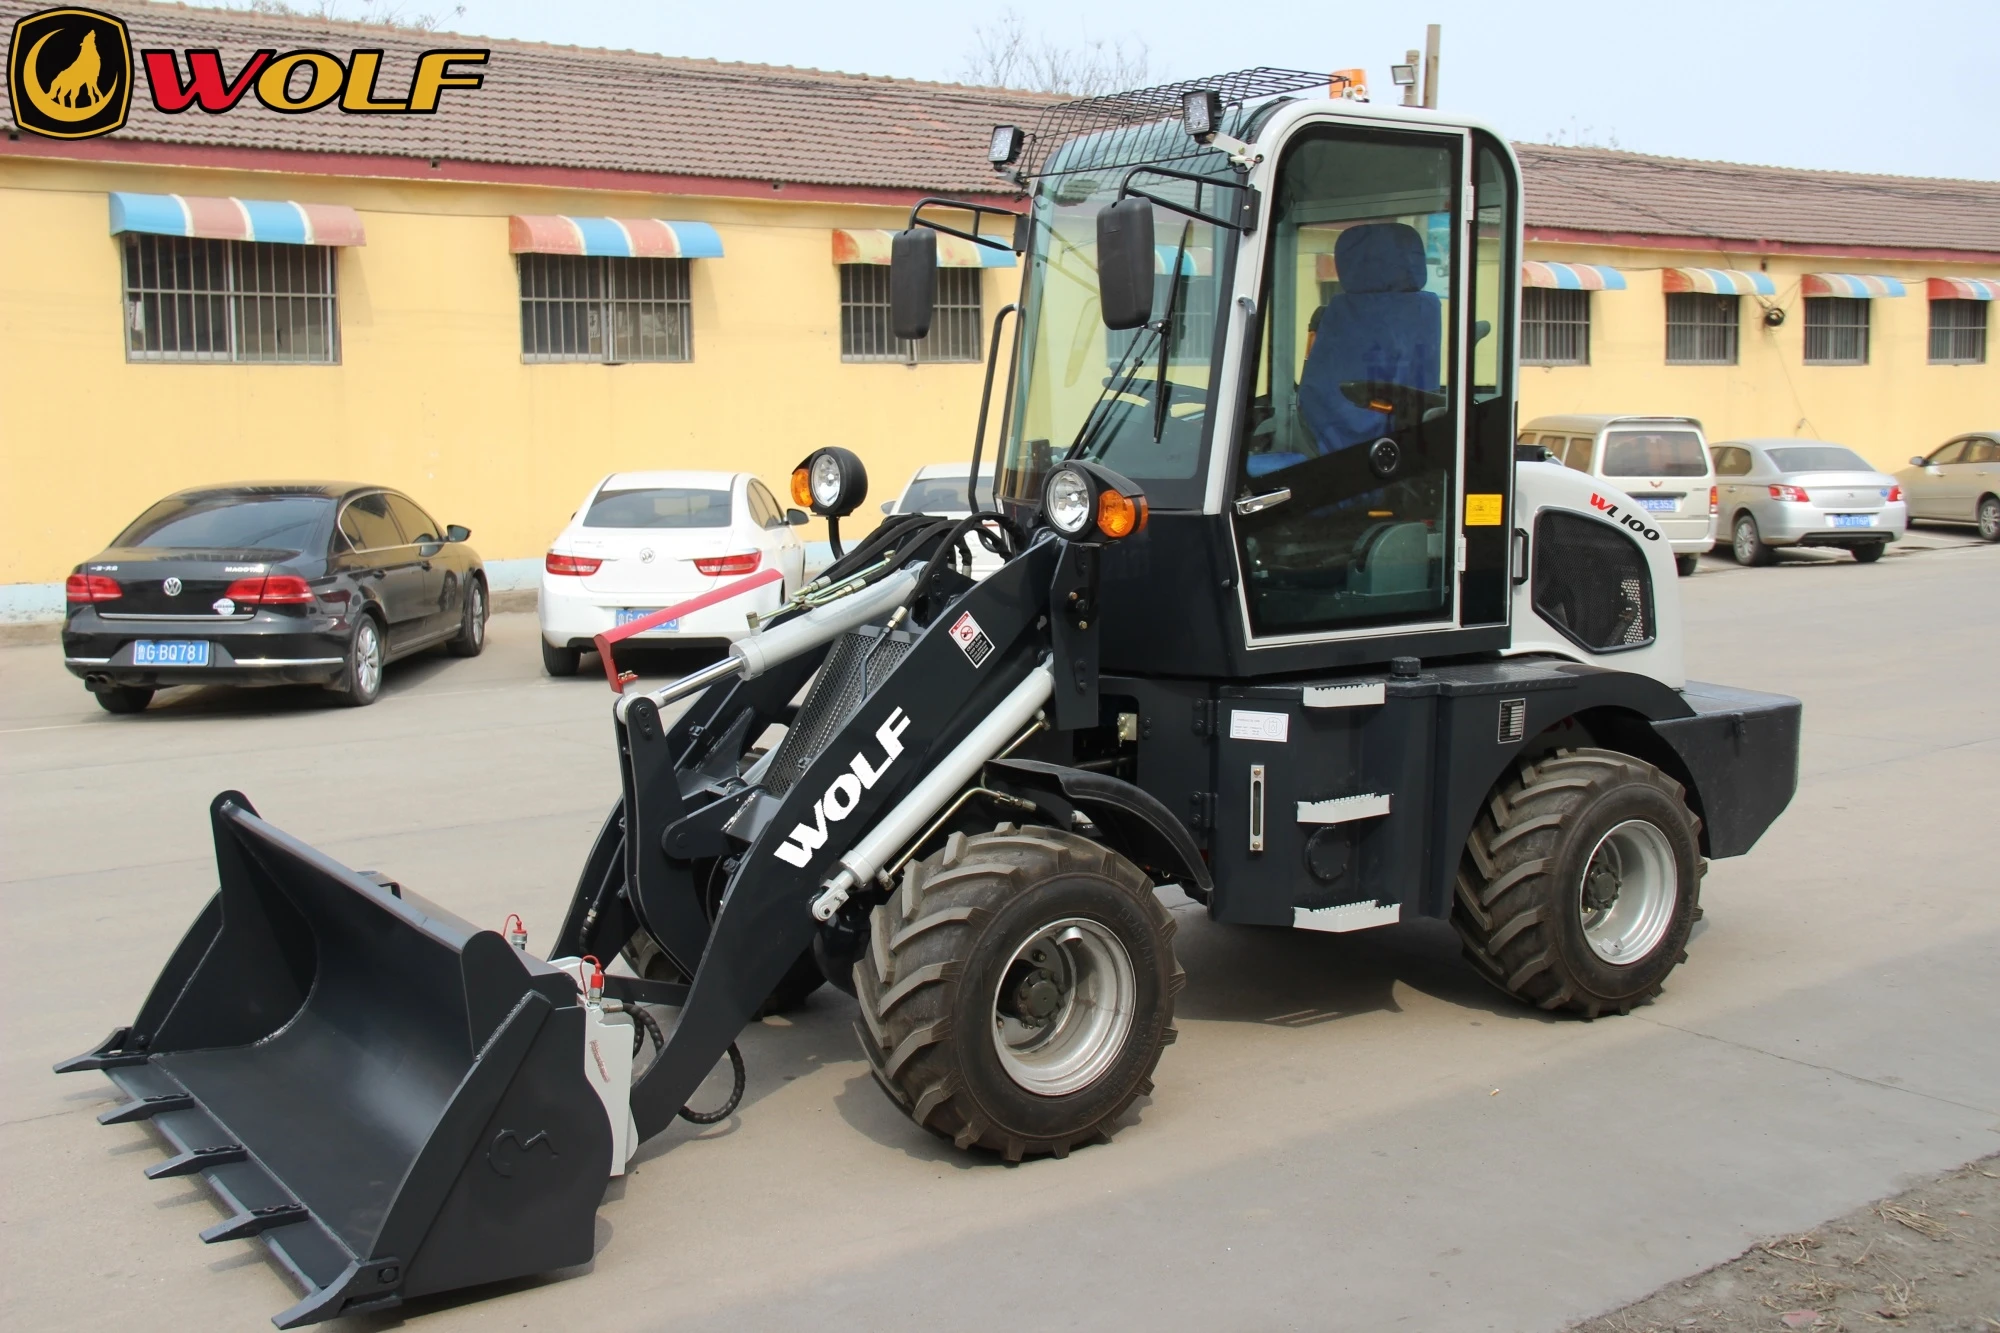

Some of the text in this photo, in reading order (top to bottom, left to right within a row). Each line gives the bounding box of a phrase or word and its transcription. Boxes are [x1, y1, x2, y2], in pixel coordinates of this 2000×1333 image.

[1590, 493, 1660, 541] WL 100
[773, 706, 911, 868] WOLF
